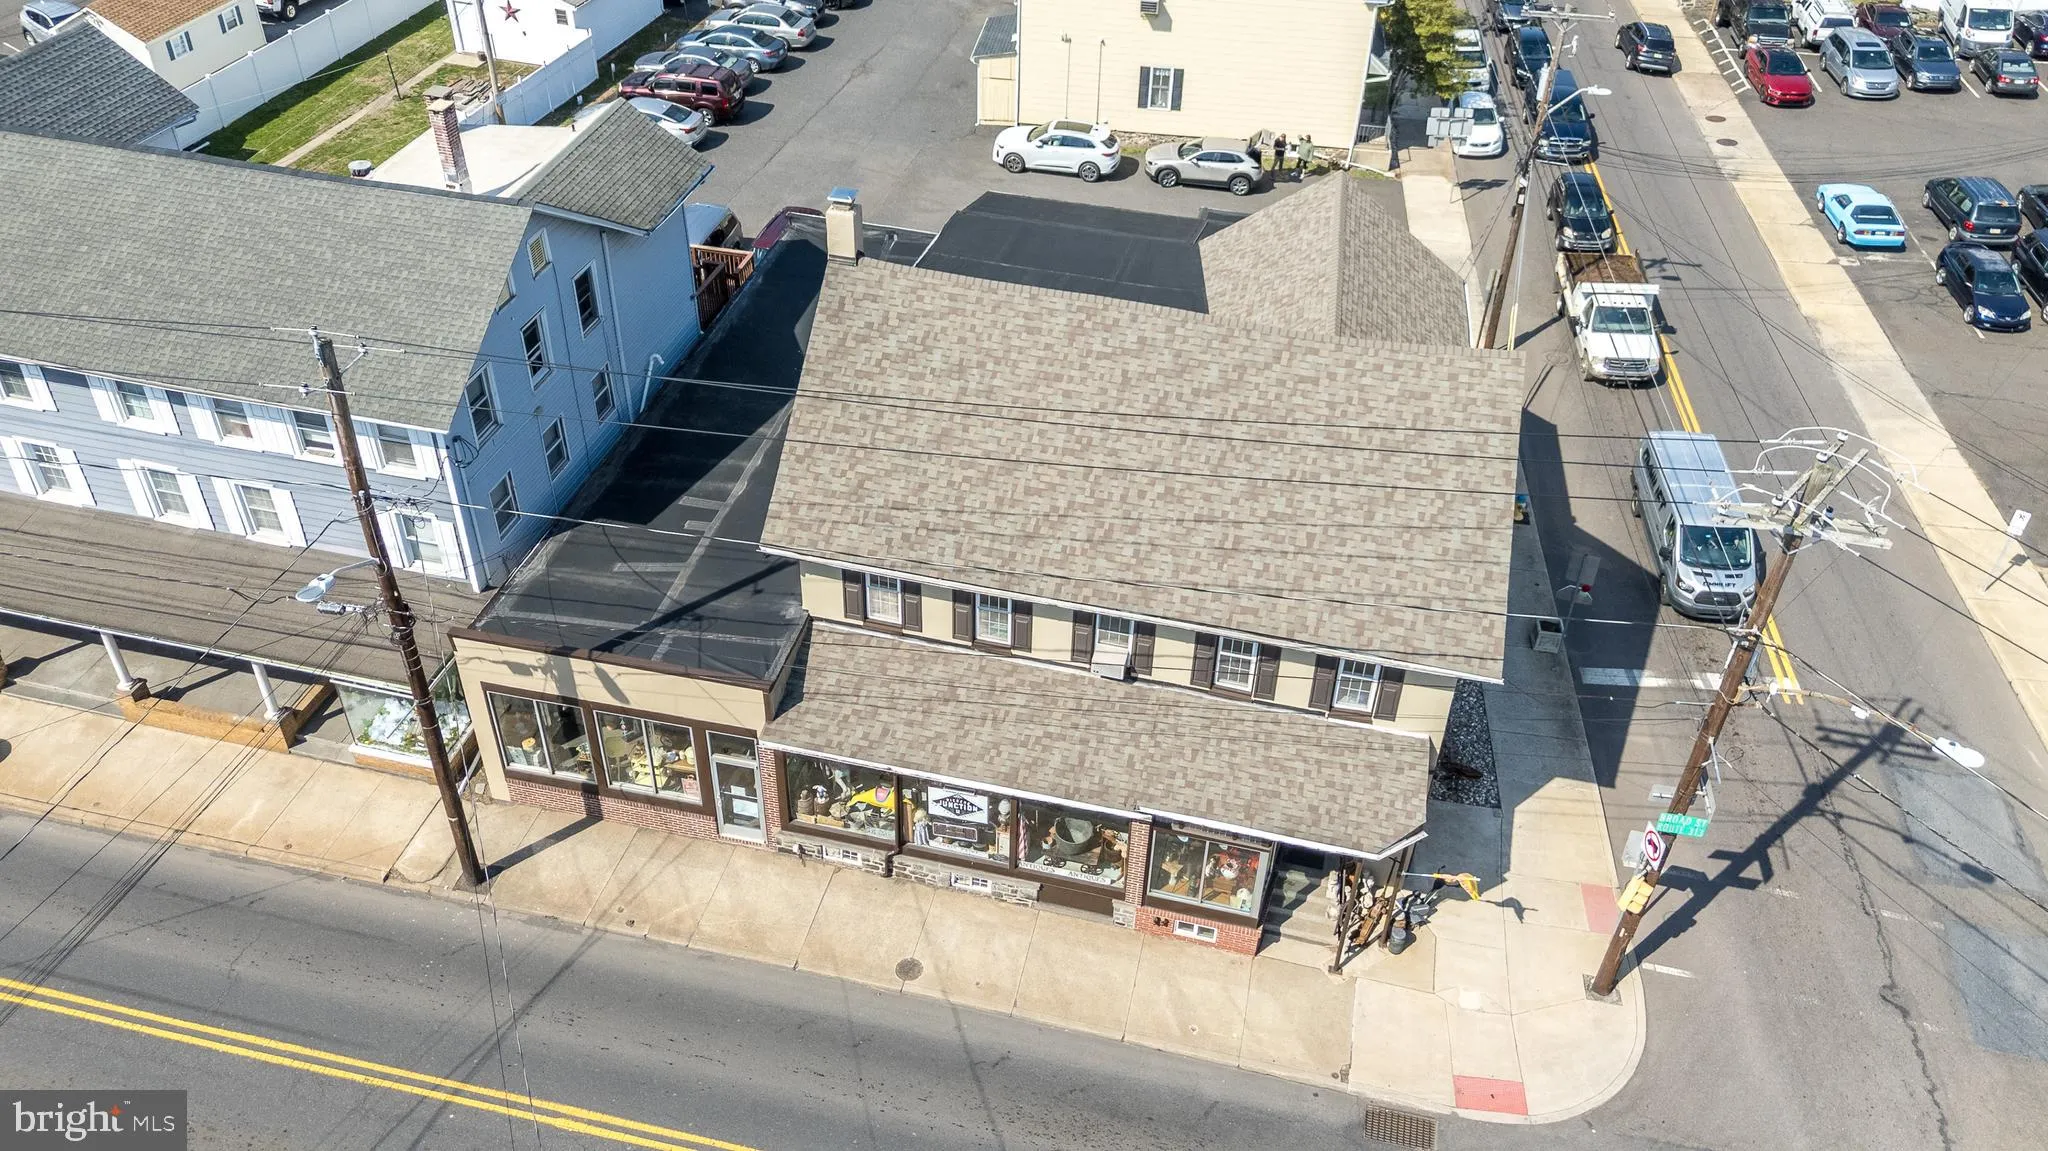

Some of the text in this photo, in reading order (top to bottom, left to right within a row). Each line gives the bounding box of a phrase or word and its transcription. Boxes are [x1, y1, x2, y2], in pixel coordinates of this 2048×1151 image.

[938, 799, 979, 812] JUNCTION
[1659, 812, 1709, 827] BROAD ST
[1656, 823, 1685, 835] ROUTE
[1018, 861, 1056, 874] ANTIQUES
[1068, 871, 1107, 884] ANTIQUES
